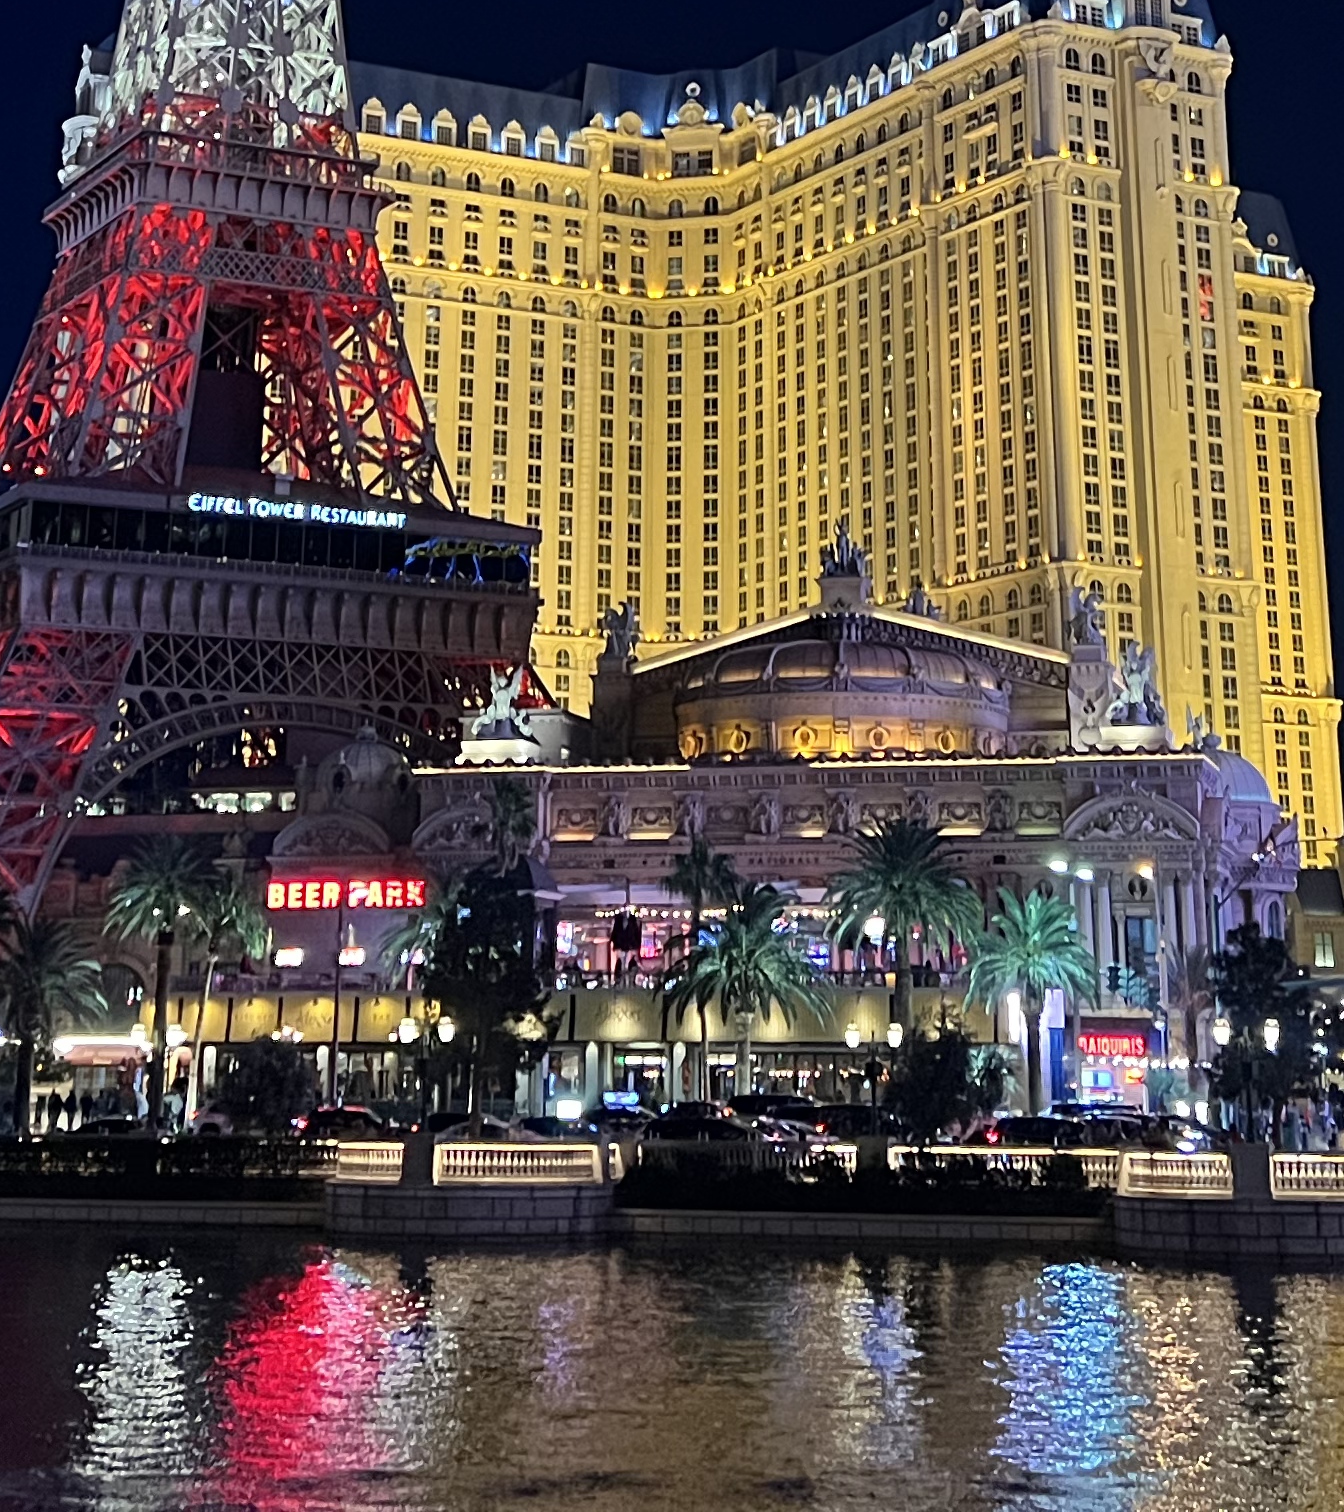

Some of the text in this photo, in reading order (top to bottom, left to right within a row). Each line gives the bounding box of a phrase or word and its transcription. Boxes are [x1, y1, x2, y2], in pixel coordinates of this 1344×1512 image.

[188, 492, 406, 529] EIFFEL TOWER RESTAURANT
[267, 880, 425, 909] BEER PARK
